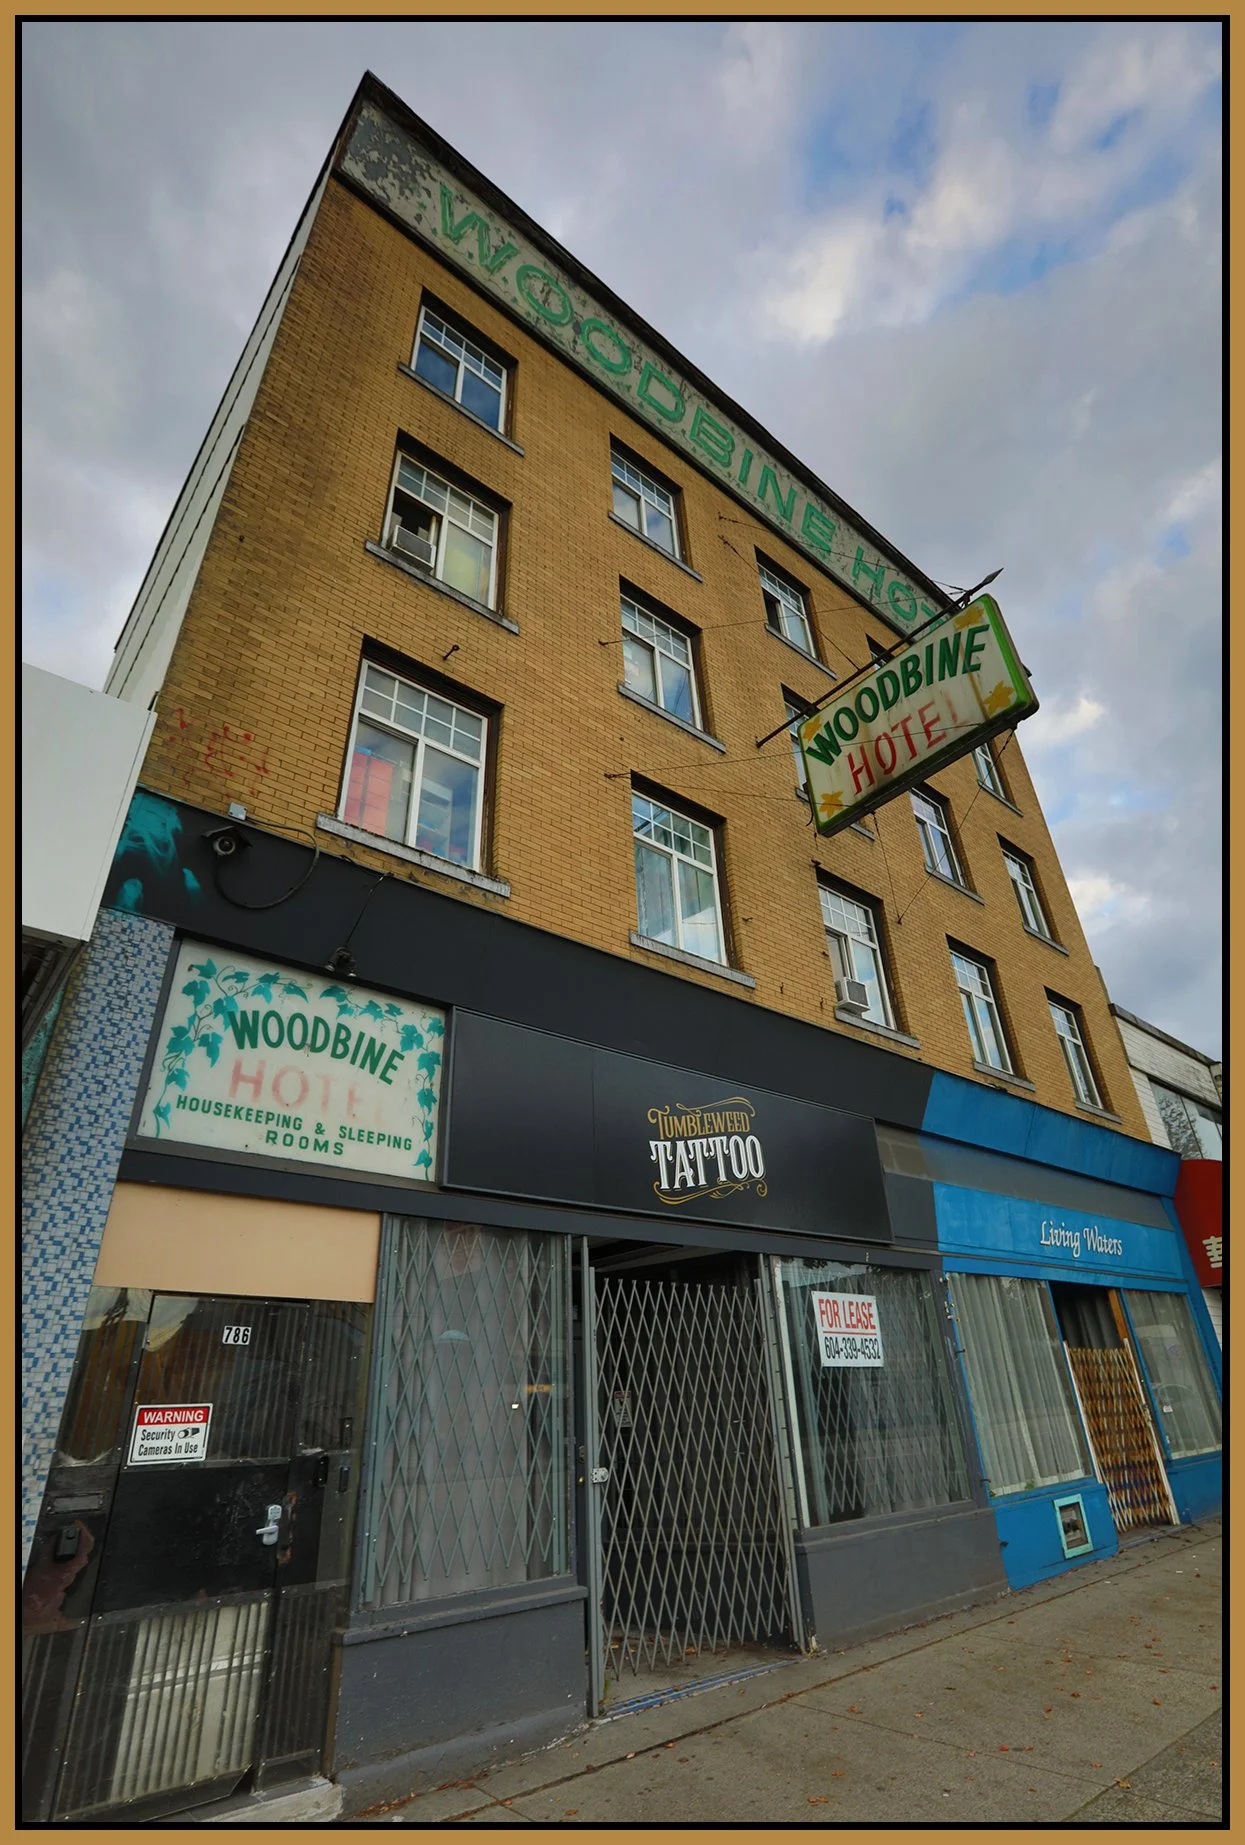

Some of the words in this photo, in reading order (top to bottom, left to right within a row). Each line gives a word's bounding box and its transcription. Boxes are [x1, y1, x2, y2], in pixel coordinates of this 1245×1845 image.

[439, 182, 838, 561] WOODBINE
[805, 623, 991, 767] WOODBINE
[228, 1009, 405, 1086] WOODBINE
[175, 1094, 304, 1131] HOUSEKEEPING
[314, 1122, 326, 1136] &
[338, 1126, 413, 1151] SLEEPING
[647, 1105, 751, 1140] TUMBLEWEED
[265, 1130, 345, 1156] ROOMS
[649, 1135, 765, 1190] TATTOO
[1040, 1220, 1081, 1258] Living
[1083, 1225, 1123, 1256] Waters
[818, 1298, 842, 1329] FOR
[842, 1300, 877, 1330] LEASE
[224, 1326, 250, 1344] 786
[824, 1336, 881, 1360] 604-339-4532
[143, 1410, 204, 1424] WARNING
[138, 1445, 175, 1457] Cameras
[175, 1442, 182, 1454] In
[184, 1442, 198, 1455] Use
[141, 1428, 176, 1442] Security
